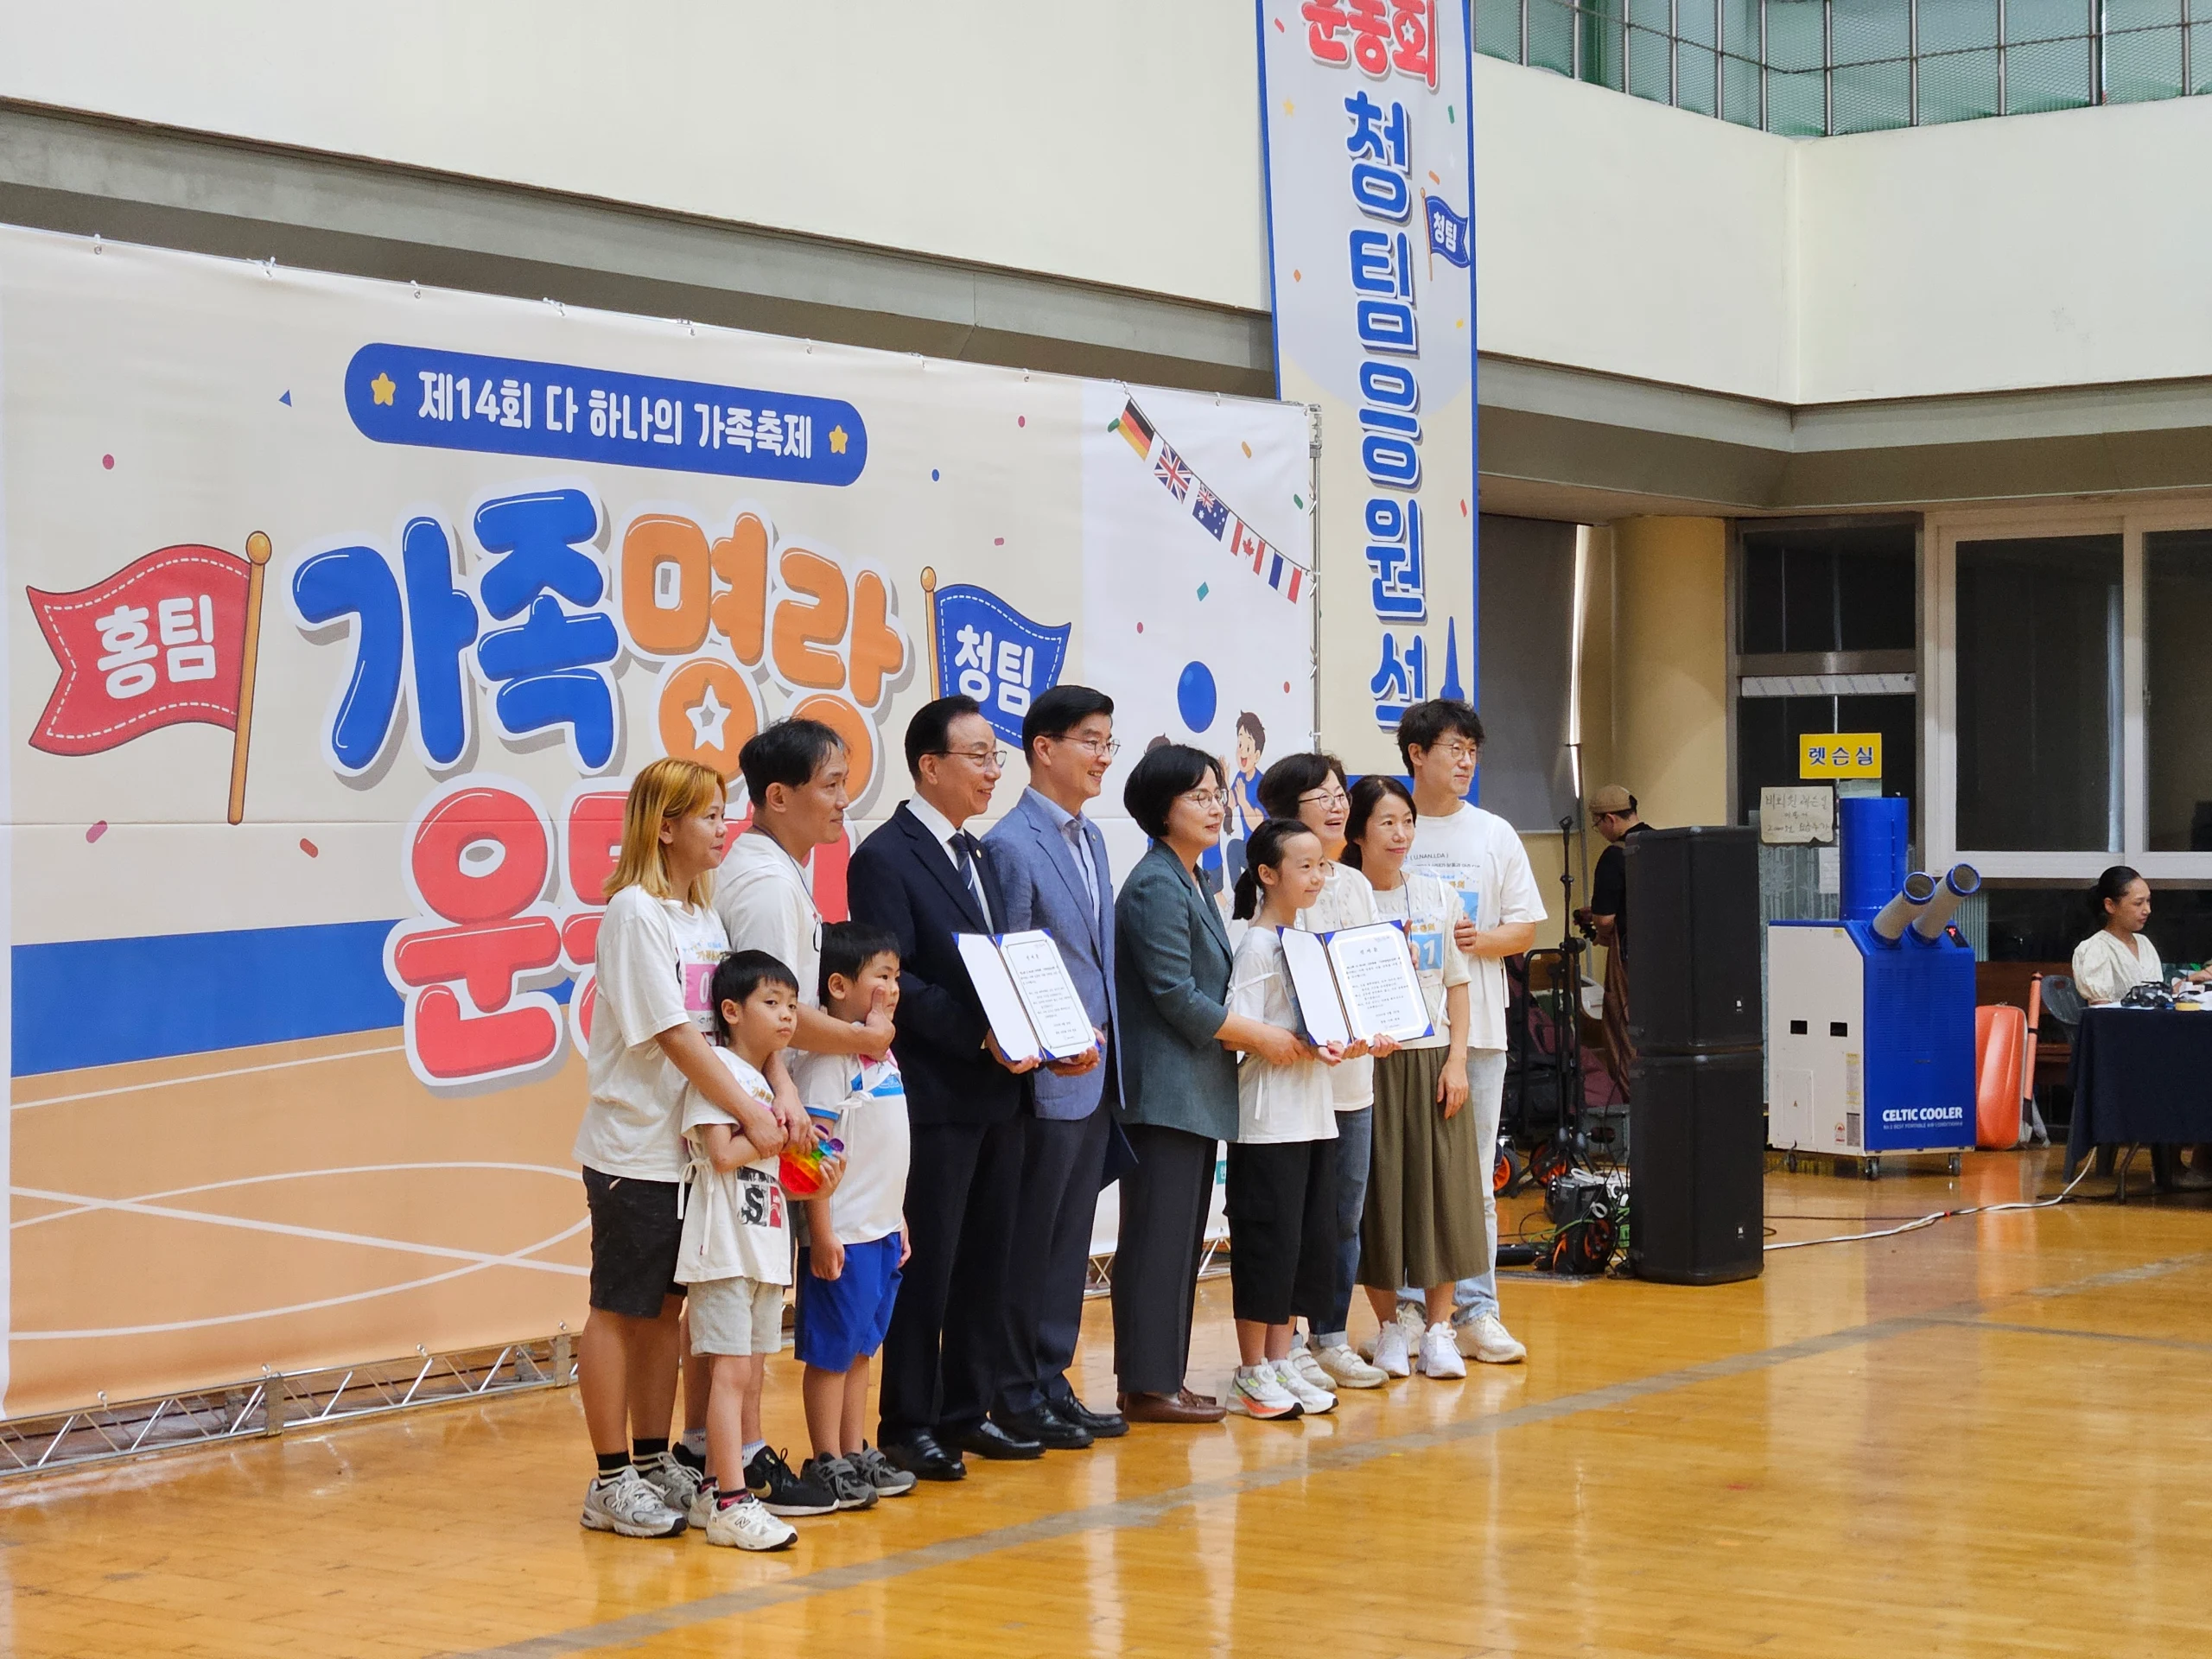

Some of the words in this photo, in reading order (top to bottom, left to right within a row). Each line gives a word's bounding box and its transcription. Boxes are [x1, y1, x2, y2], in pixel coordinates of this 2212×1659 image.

[1433, 211, 1457, 253] 청팀
[418, 370, 532, 430] 제14회
[545, 387, 579, 435] 다
[588, 389, 683, 446] 하나의
[694, 403, 812, 460] 가족축제
[95, 594, 218, 701] 홍팀
[954, 624, 1034, 718] 청팀
[1808, 747, 1873, 766] 렛슨실
[1882, 1109, 1918, 1122] CELTIC
[1919, 1107, 1963, 1121] COOLER
